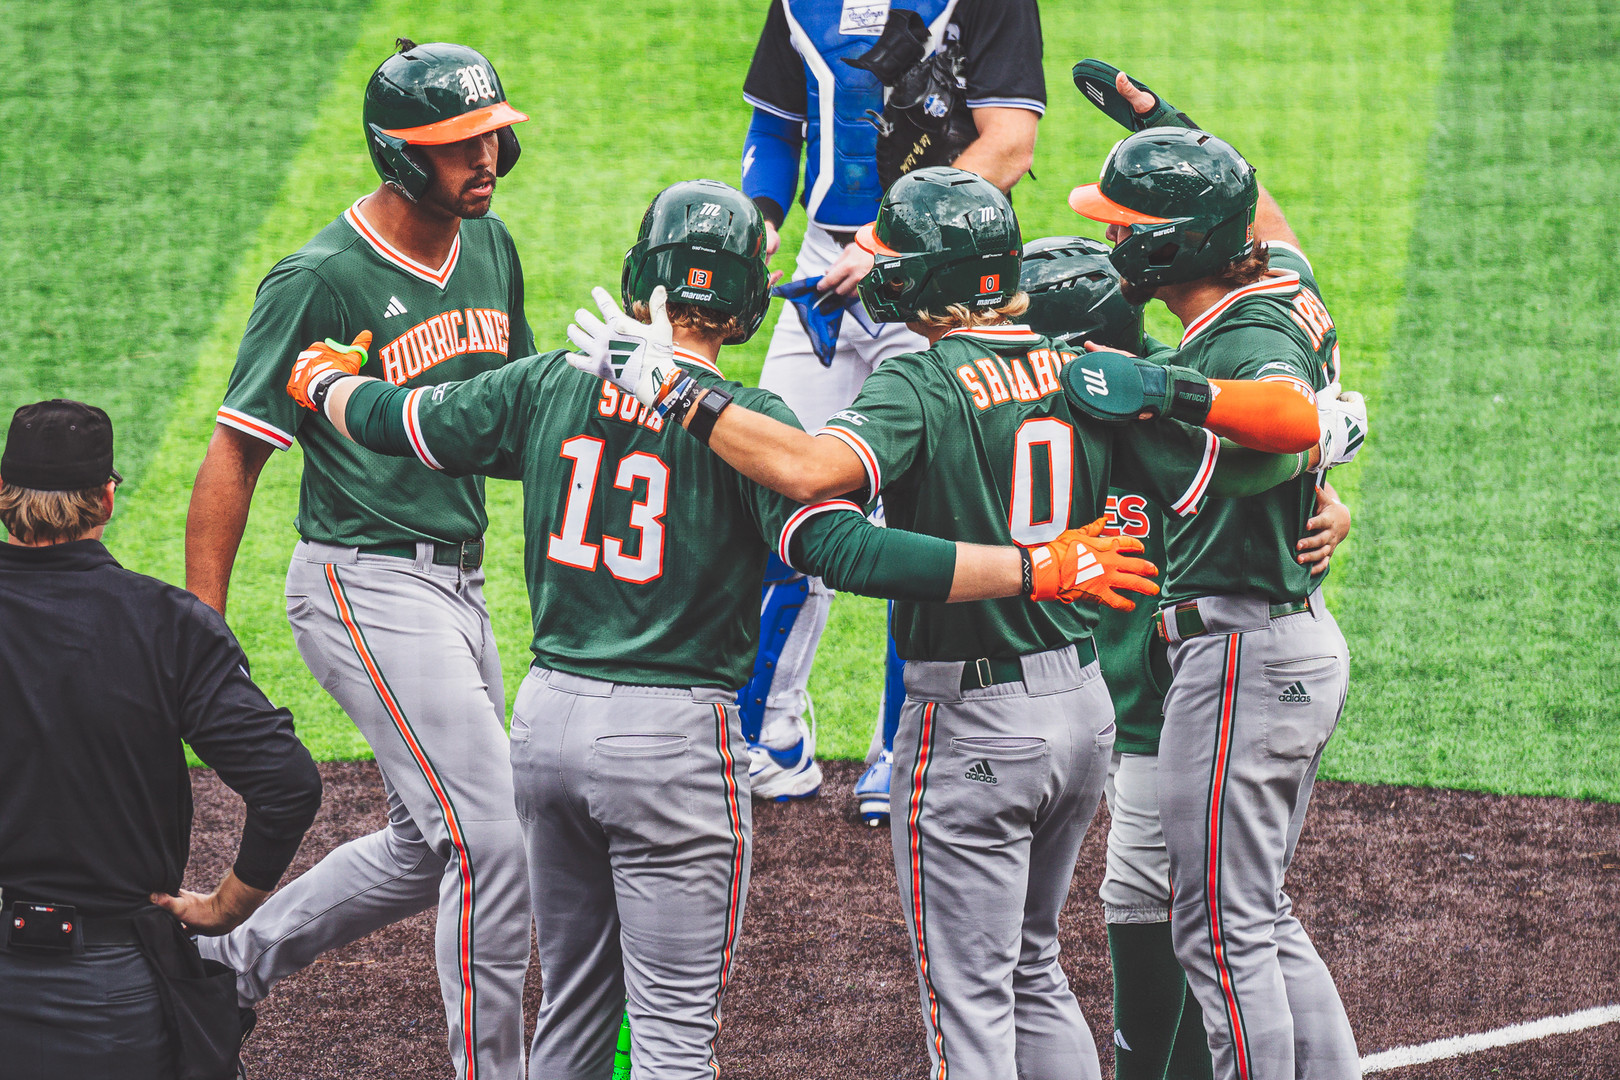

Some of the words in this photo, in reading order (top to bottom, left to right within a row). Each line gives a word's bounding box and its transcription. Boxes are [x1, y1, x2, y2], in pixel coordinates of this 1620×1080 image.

[690, 269, 708, 287] 13
[985, 276, 995, 291] 0
[680, 289, 713, 302] marucci
[379, 308, 510, 386] HURRICANES
[1178, 391, 1207, 403] marucci
[1007, 416, 1074, 549] 0
[546, 433, 671, 585] 13
[1278, 693, 1312, 704] adidas
[964, 771, 998, 785] adidas
